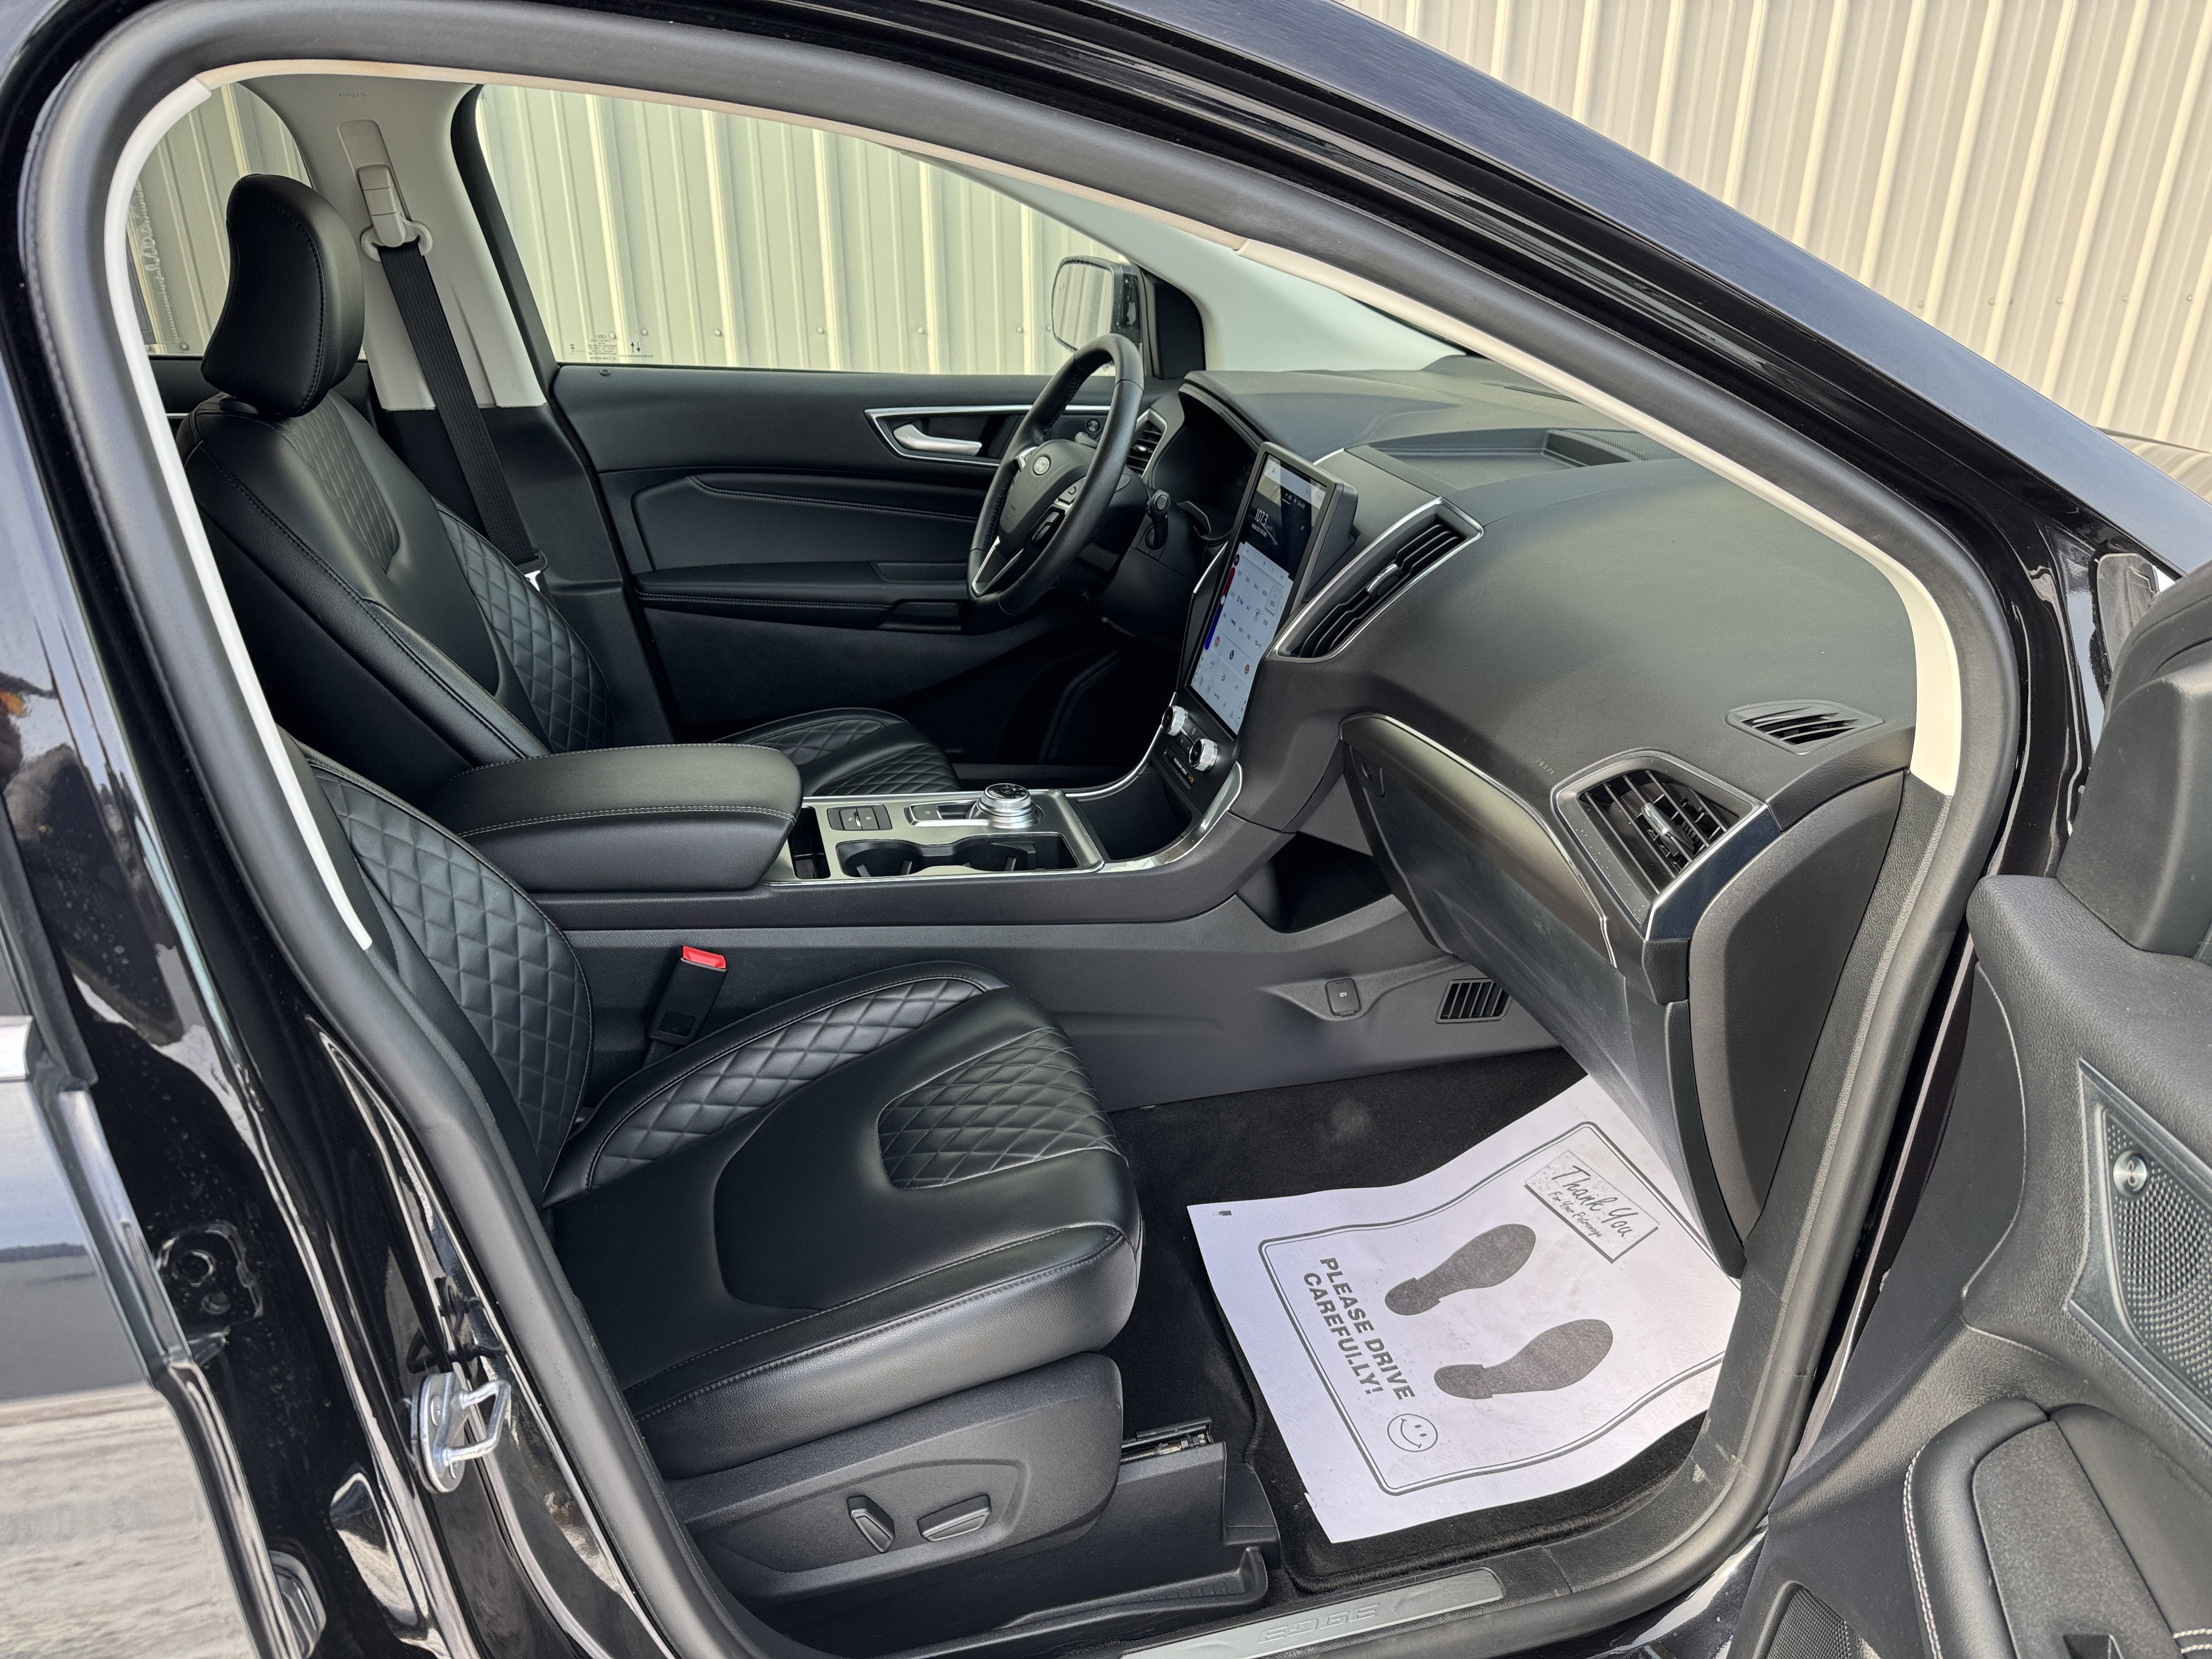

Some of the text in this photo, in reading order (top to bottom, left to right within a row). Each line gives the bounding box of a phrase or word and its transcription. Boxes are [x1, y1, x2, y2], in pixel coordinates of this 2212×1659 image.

[1548, 1191, 1602, 1238] For Your Patronage
[1551, 1165, 1639, 1237] Thank You
[1304, 1272, 1384, 1395] CAREFULLY!
[1319, 1257, 1416, 1400] PLEASE DRIVE
[1258, 1604, 1378, 1645] EDGE
